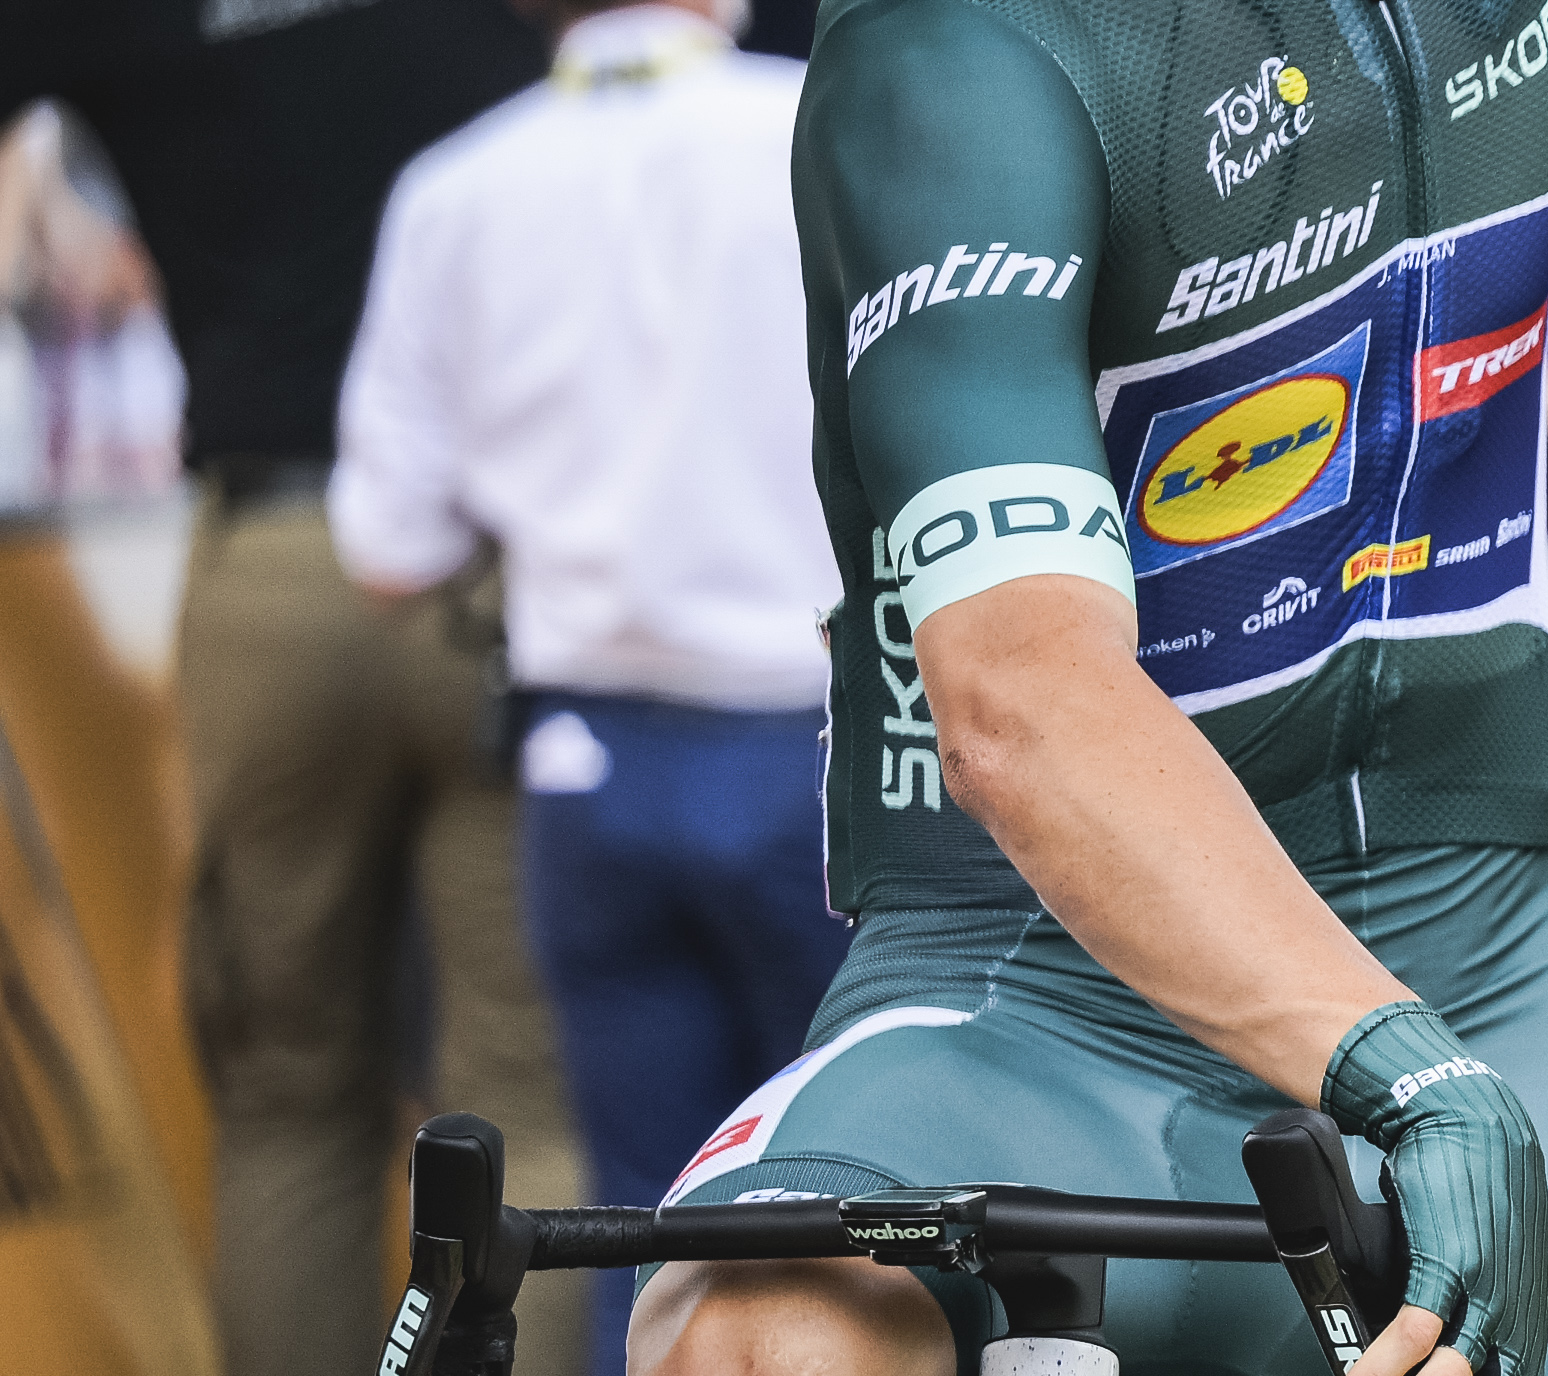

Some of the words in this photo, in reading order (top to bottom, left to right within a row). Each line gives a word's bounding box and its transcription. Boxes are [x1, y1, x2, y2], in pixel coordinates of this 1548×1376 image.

[1155, 179, 1384, 335] Santini
[1398, 238, 1456, 276] MILAN
[846, 241, 1083, 381] Santini
[1432, 319, 1544, 396] TREK
[897, 495, 1132, 586] ODA
[1241, 585, 1322, 636] CRIVIT
[872, 525, 942, 813] SKO
[847, 1222, 940, 1243] wahoo
